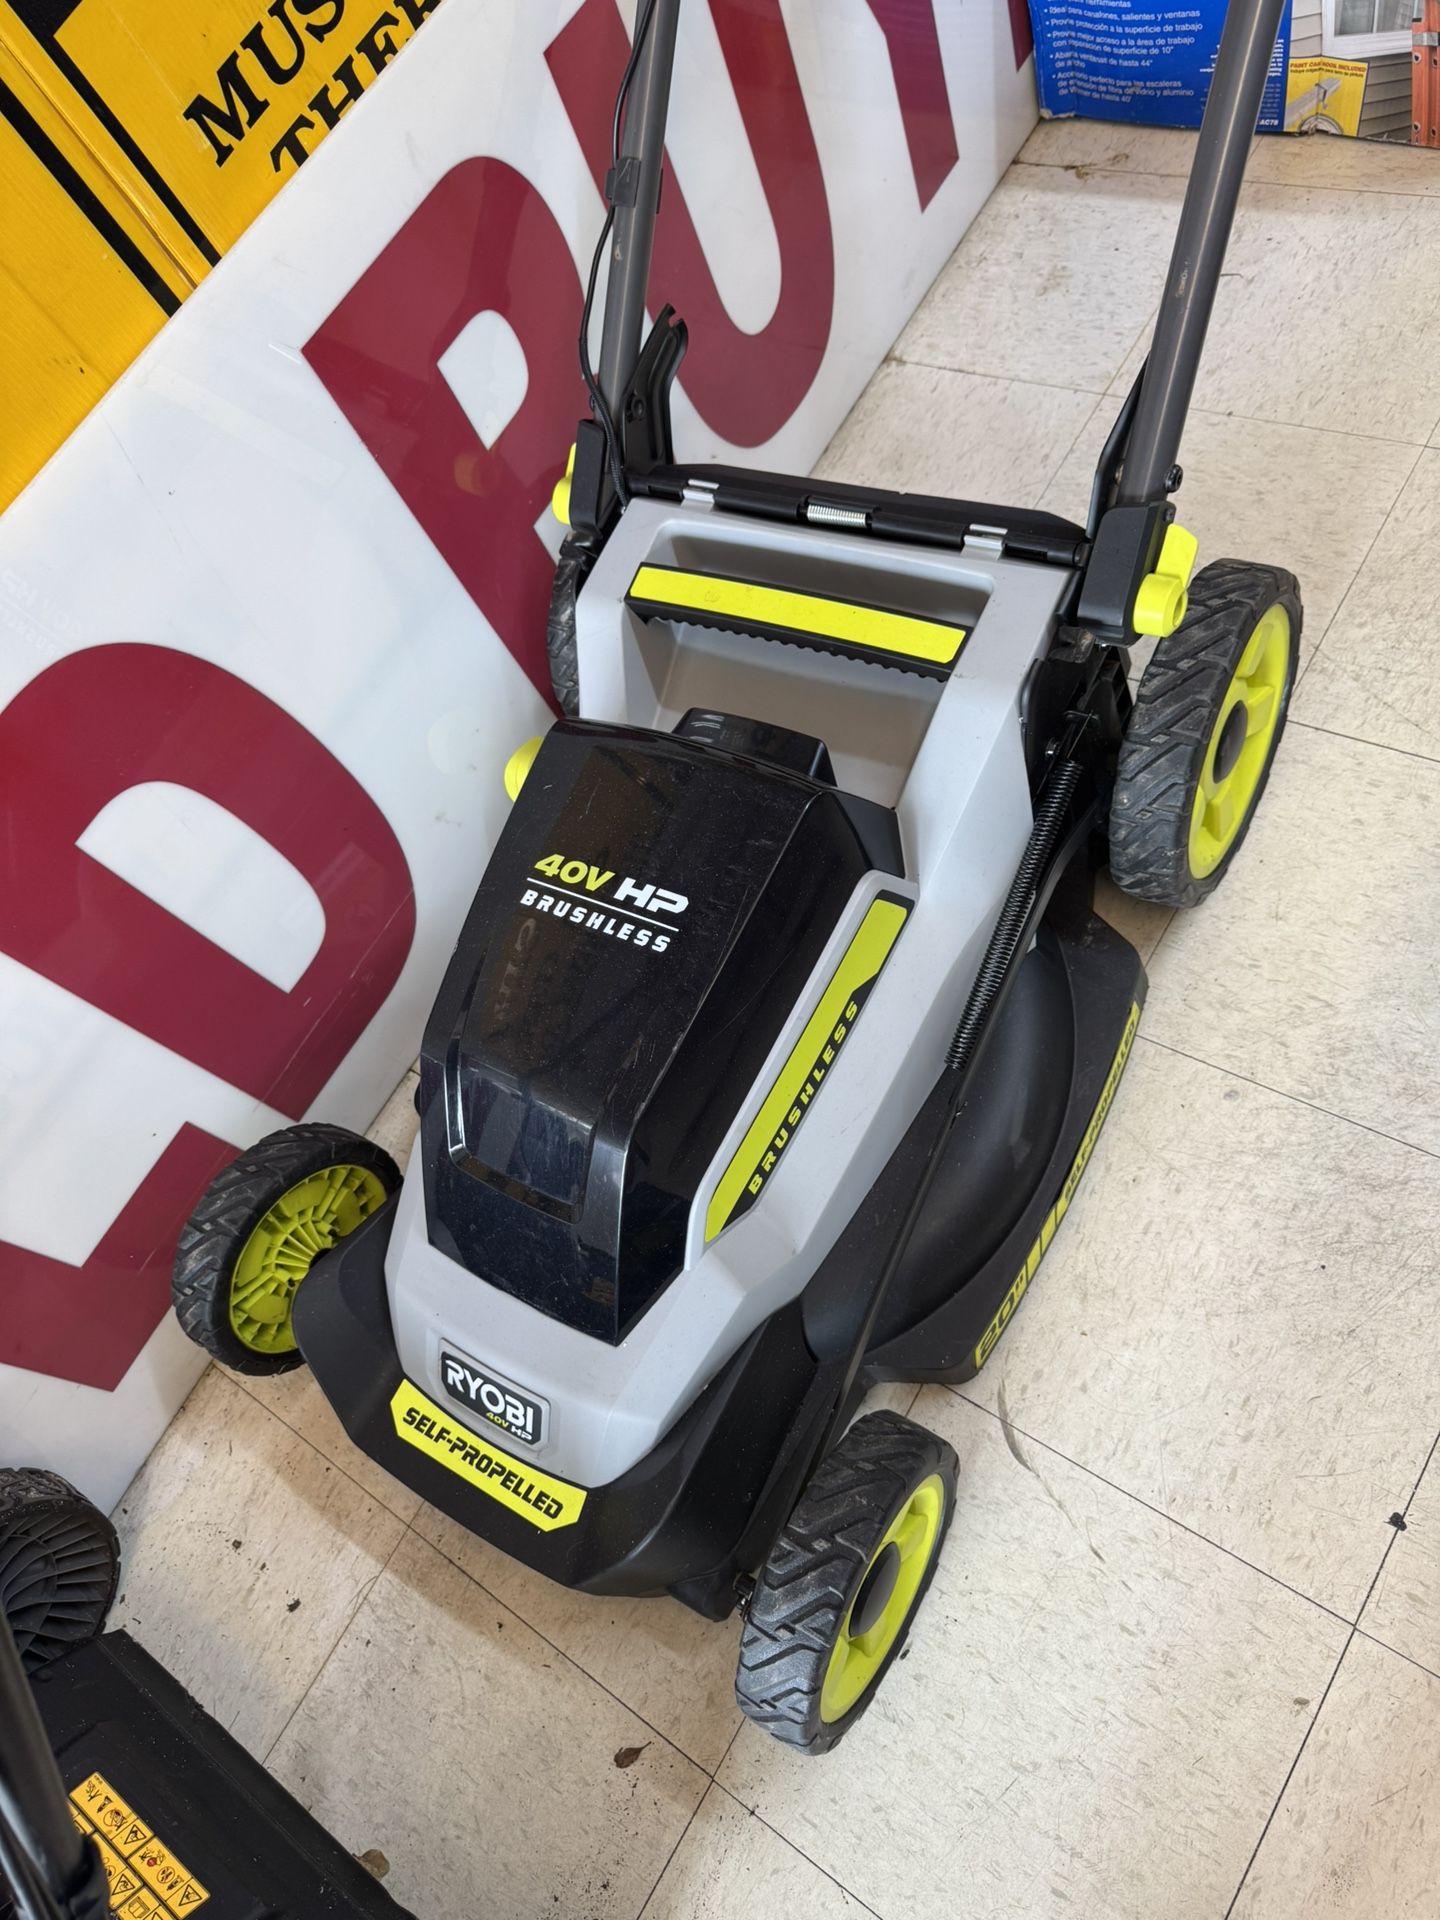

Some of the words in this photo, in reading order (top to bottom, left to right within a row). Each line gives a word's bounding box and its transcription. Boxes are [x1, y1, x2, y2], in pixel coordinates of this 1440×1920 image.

[1068, 7, 1083, 16] para
[1121, 12, 1155, 20] salientes
[1157, 13, 1162, 21] y
[1164, 10, 1200, 19] ventanas
[1116, 25, 1123, 33] la
[1124, 26, 1161, 35] superficie
[1163, 24, 1173, 32] de
[1175, 23, 1203, 32] trabajo
[1053, 40, 1067, 48] con
[1149, 46, 1160, 55] de
[1127, 38, 1135, 46] la
[1155, 38, 1166, 46] de
[1167, 36, 1195, 45] trabajo
[1119, 59, 1139, 67] hasta
[1146, 80, 1182, 88] escaleras
[1162, 89, 1195, 97] aluminio
[534, 853, 616, 892] 40V
[613, 877, 689, 914] HP
[520, 889, 671, 953] BRUSHLESS
[748, 1001, 857, 1195] BRUSHLESS
[1064, 1021, 1136, 1200] SELF-PROPELLED
[445, 1359, 534, 1434] RYOBI
[486, 1411, 509, 1429] 40V
[510, 1426, 533, 1441] HP
[402, 1406, 564, 1520] SELF-PROPELLED
